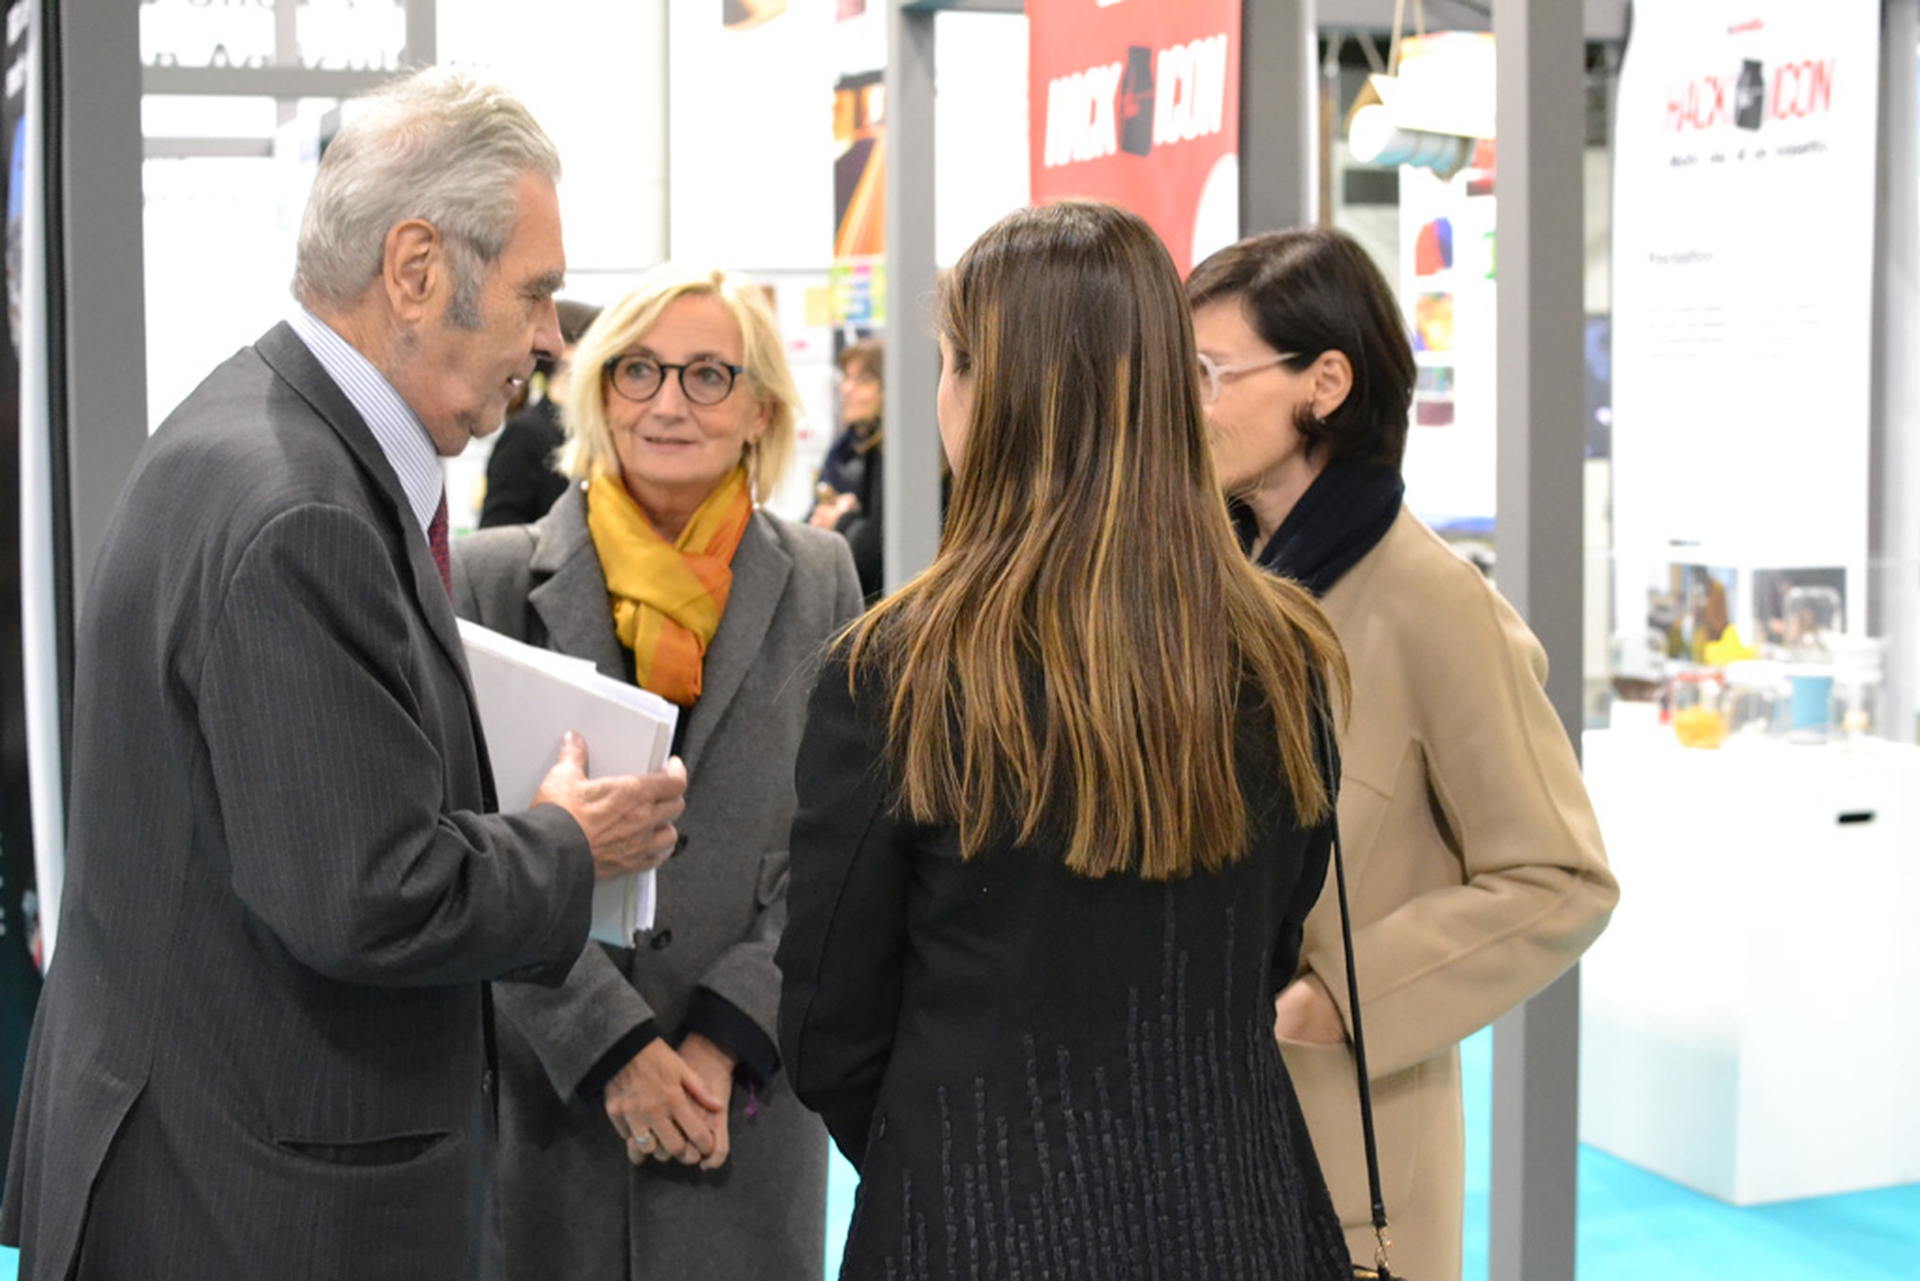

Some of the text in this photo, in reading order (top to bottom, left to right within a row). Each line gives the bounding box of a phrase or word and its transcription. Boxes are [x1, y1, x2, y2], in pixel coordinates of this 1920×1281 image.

[1044, 33, 1227, 167] HACK ICON
[1665, 58, 1835, 133] HACK ICON
